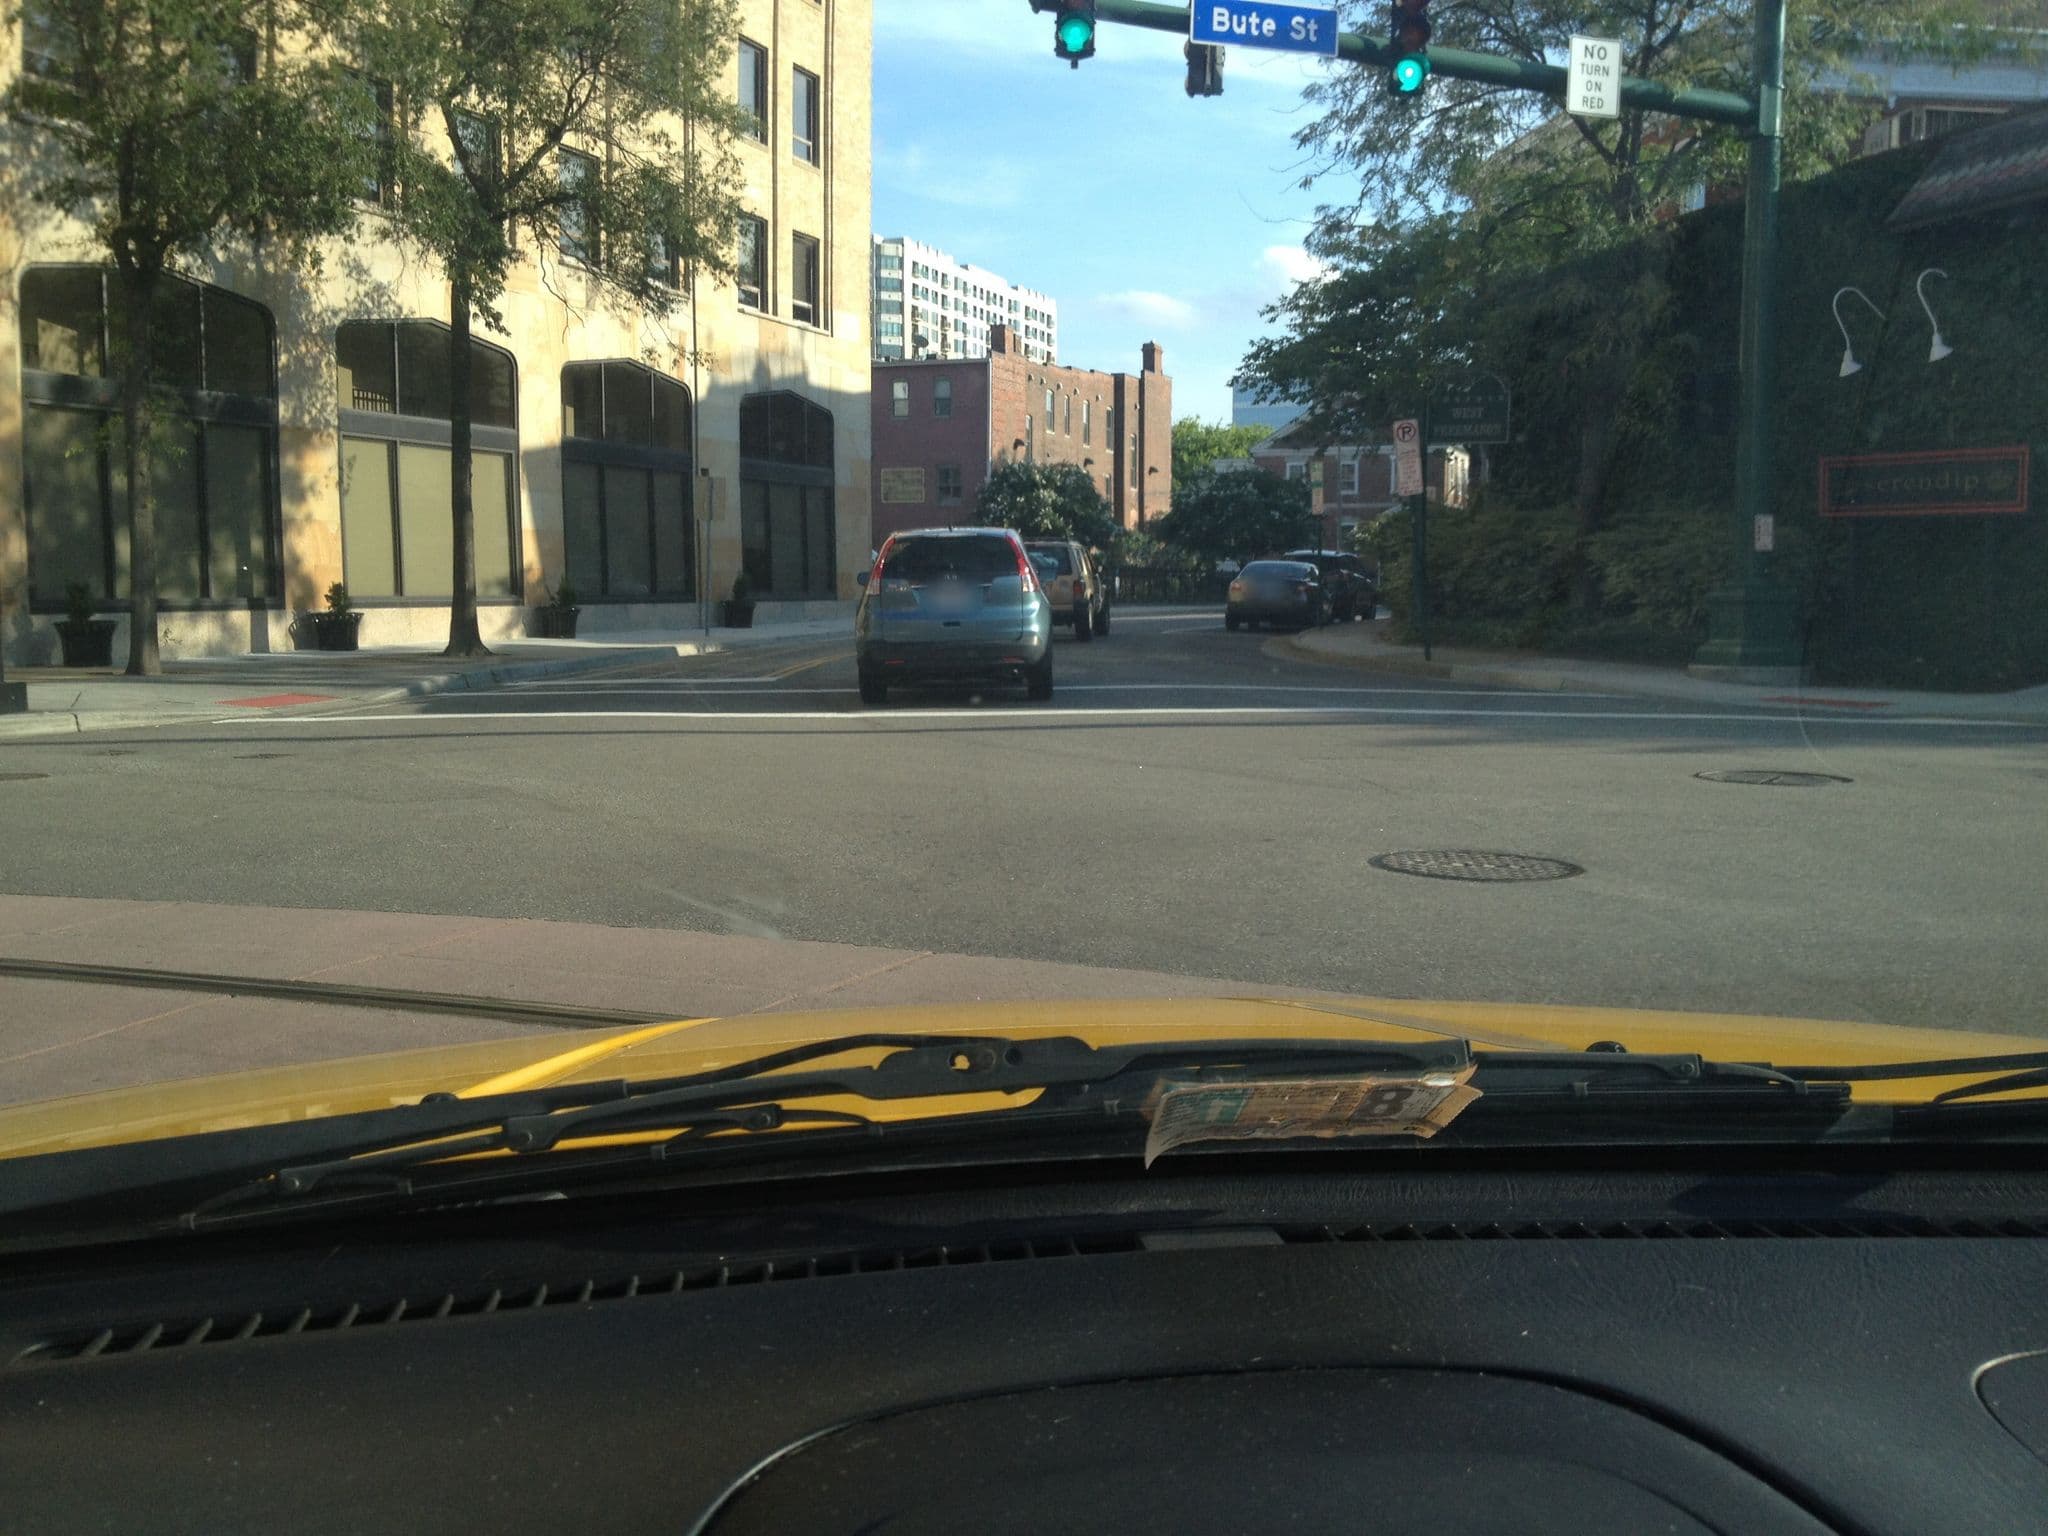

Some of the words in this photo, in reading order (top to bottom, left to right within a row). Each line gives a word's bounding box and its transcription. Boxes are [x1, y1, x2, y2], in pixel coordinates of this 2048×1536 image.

[1212, 6, 1277, 38] Bute
[1289, 15, 1318, 42] St
[1584, 44, 1607, 61] NO
[1580, 63, 1609, 77] TURN
[1585, 80, 1602, 92] ON
[1582, 96, 1604, 110] RED
